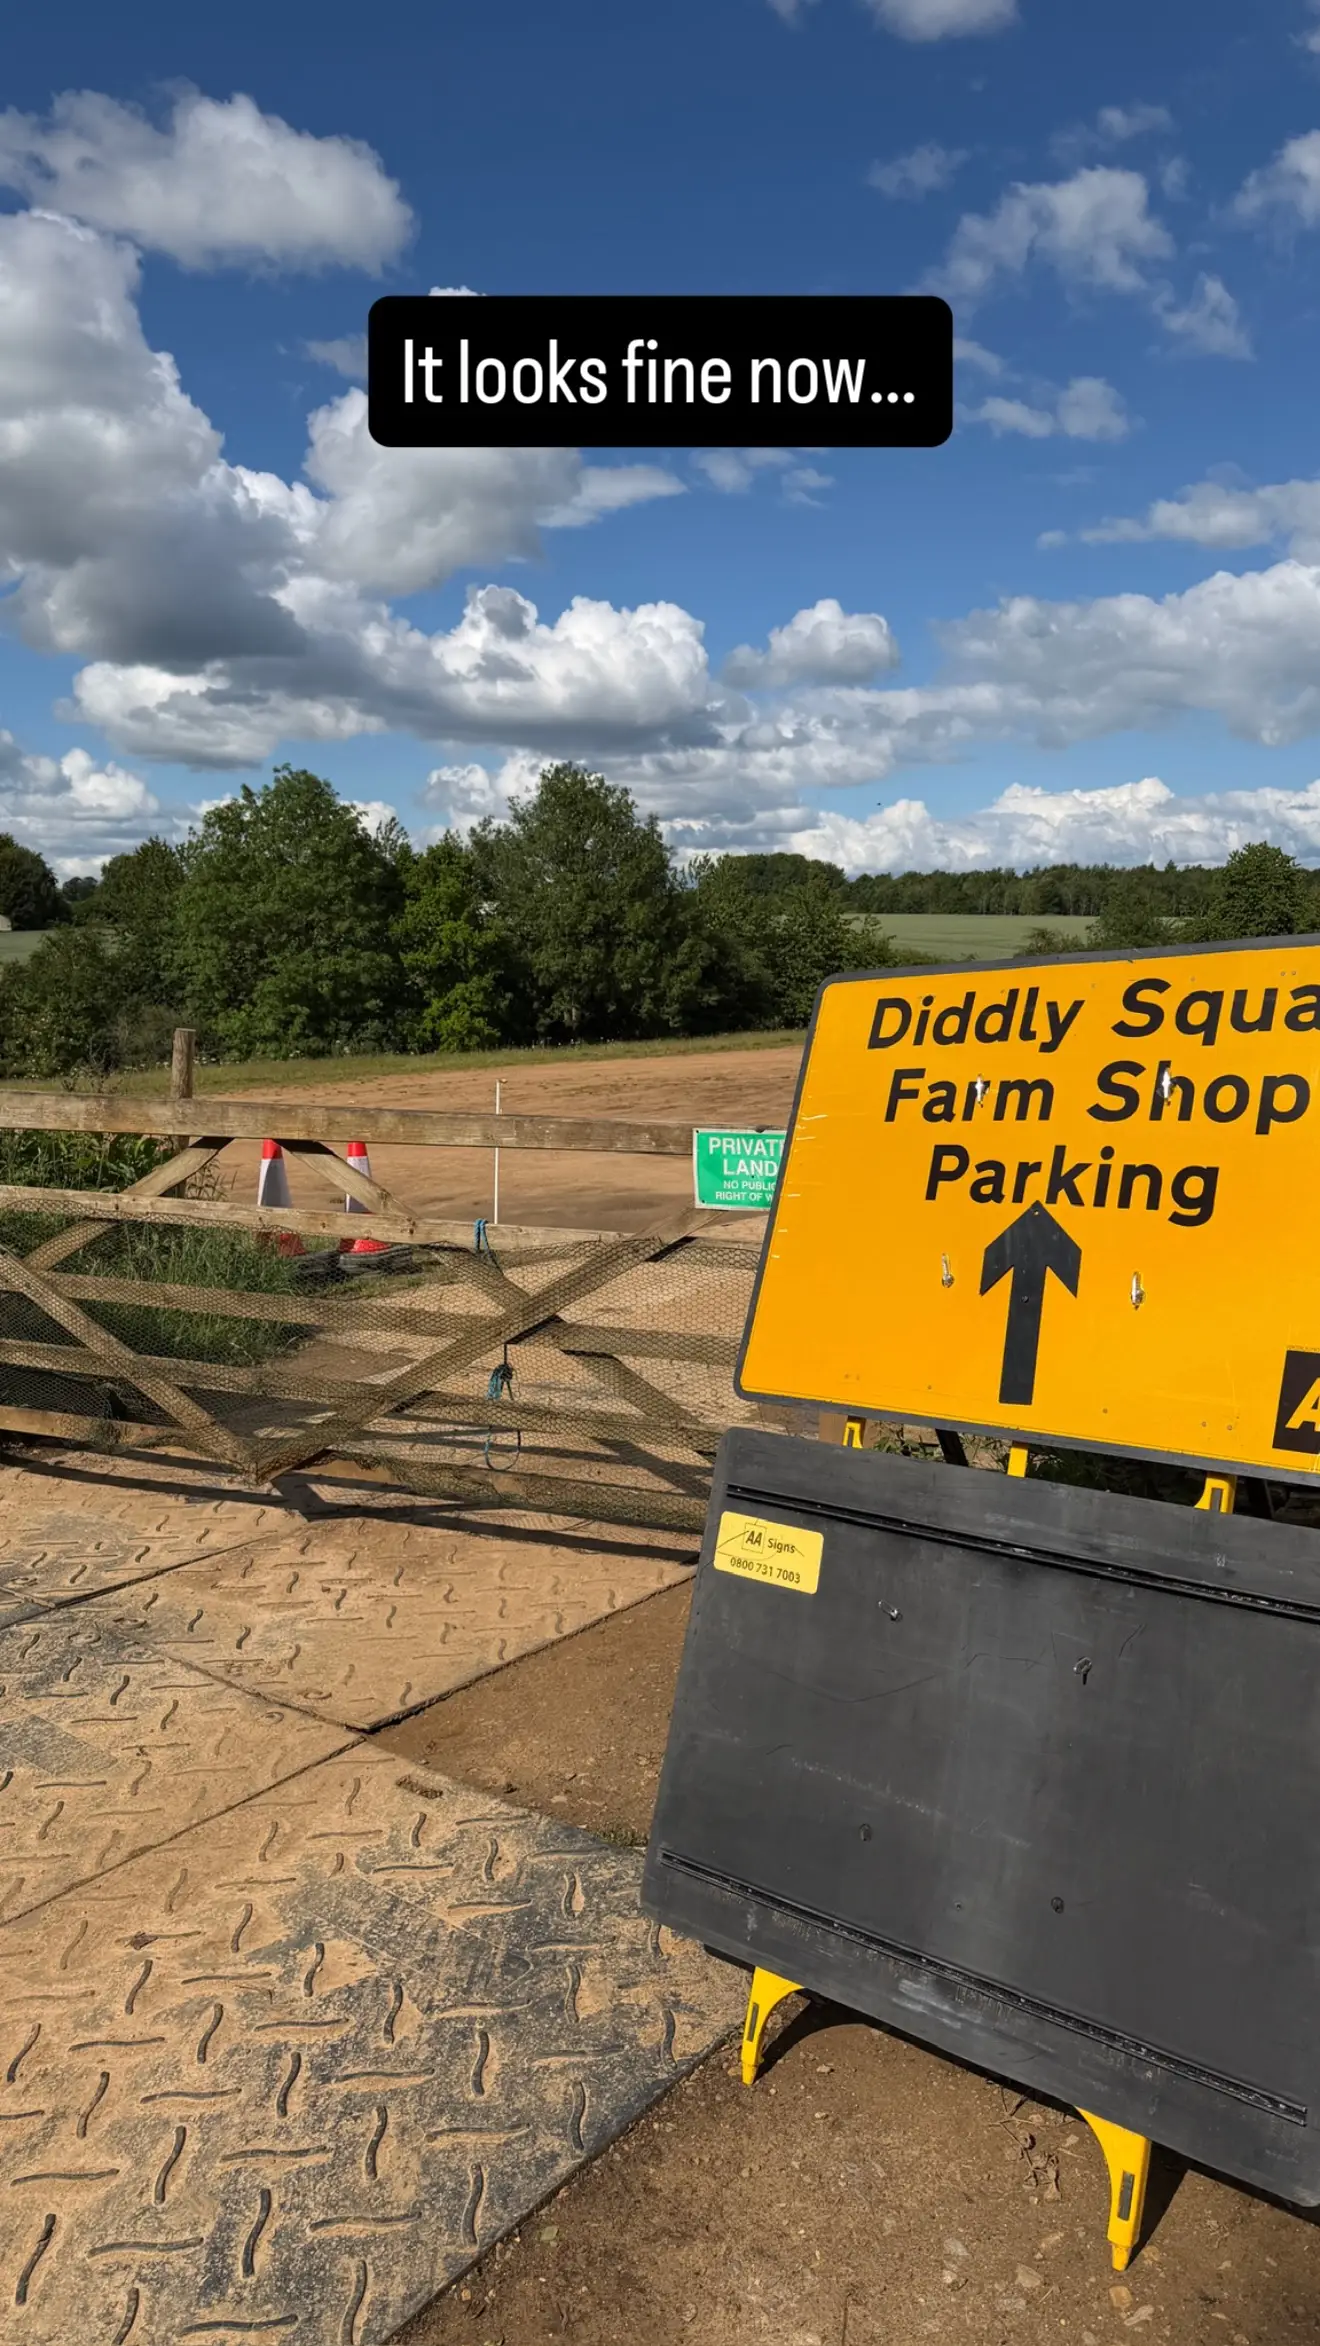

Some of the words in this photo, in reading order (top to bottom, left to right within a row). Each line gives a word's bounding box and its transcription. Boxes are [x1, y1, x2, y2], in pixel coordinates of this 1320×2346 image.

[866, 986, 1085, 1054] Diddly
[1110, 978, 1320, 1047] Squa
[884, 1067, 1056, 1123] Farm
[1086, 1060, 1311, 1136] Shop
[723, 1158, 778, 1177] LAND
[715, 1191, 747, 1201] RIGHT
[749, 1192, 763, 1202] OF
[723, 1180, 739, 1190] NO
[925, 1144, 1221, 1228] Parking
[745, 1530, 763, 1547] AA
[767, 1538, 796, 1554] Signs
[730, 1556, 755, 1571] 0800
[755, 1563, 774, 1577] 731
[776, 1568, 801, 1584] 7003
